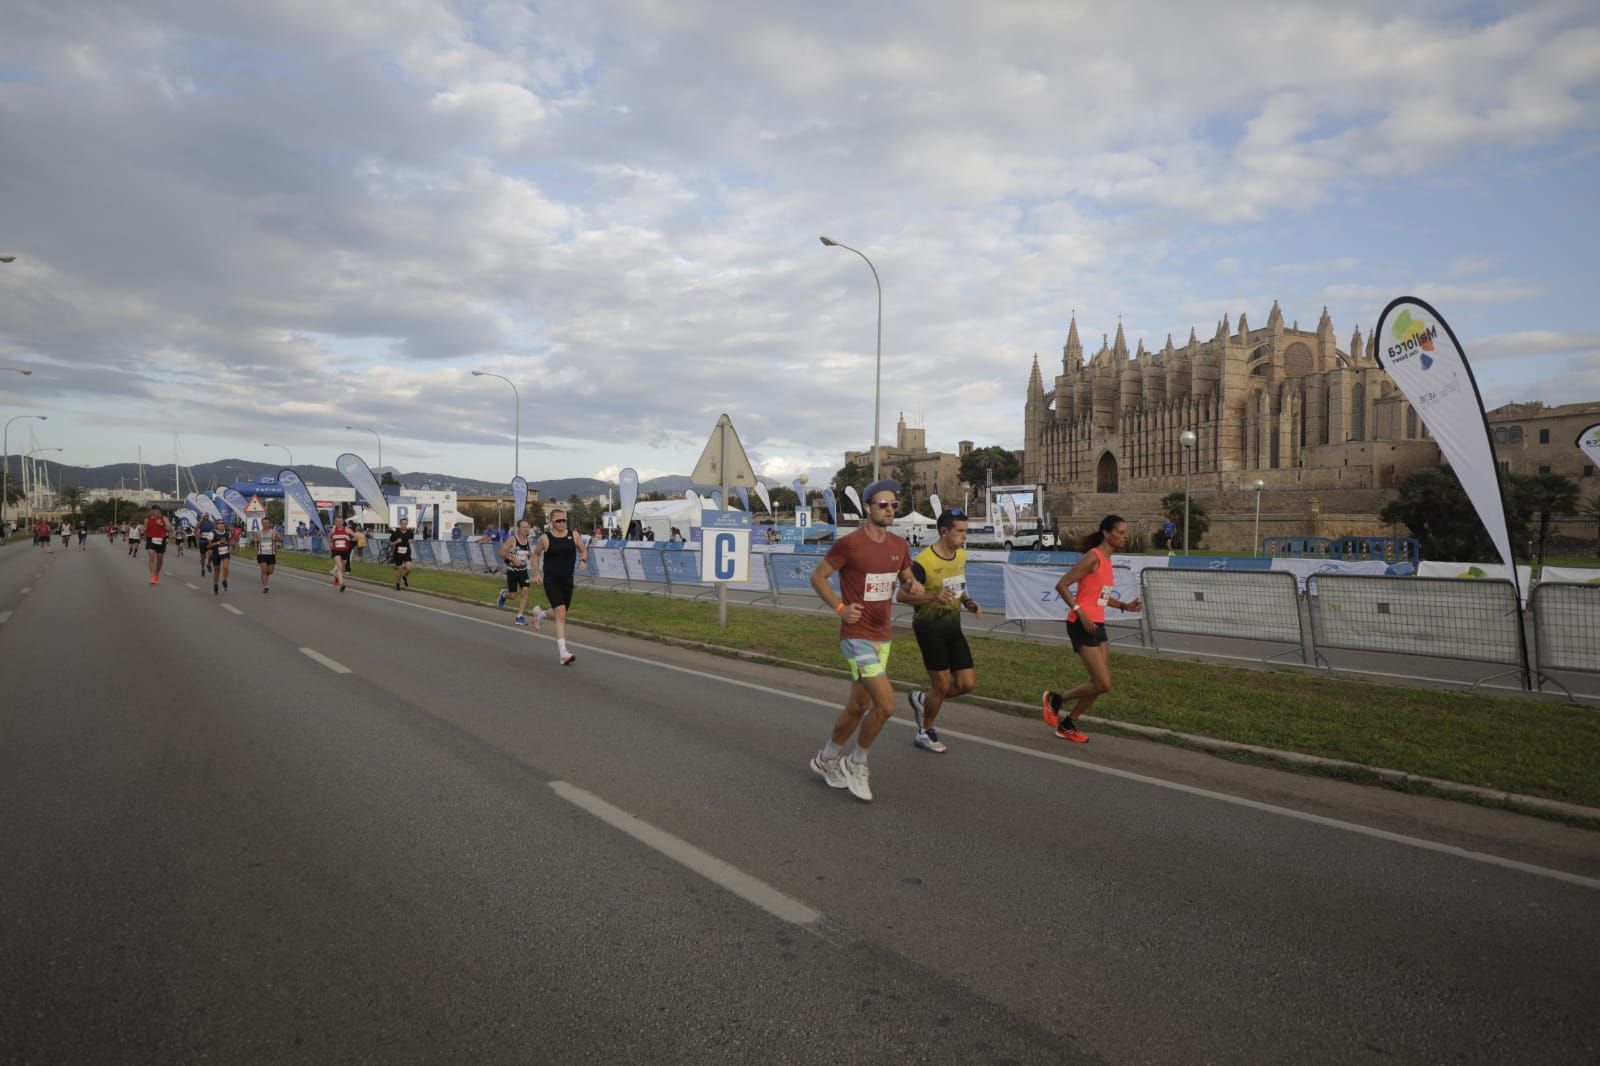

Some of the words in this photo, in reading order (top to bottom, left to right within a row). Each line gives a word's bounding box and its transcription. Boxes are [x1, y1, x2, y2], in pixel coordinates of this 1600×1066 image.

[251, 519, 259, 530] A
[608, 517, 613, 528] A
[800, 513, 806, 527] B
[714, 532, 736, 580] C
